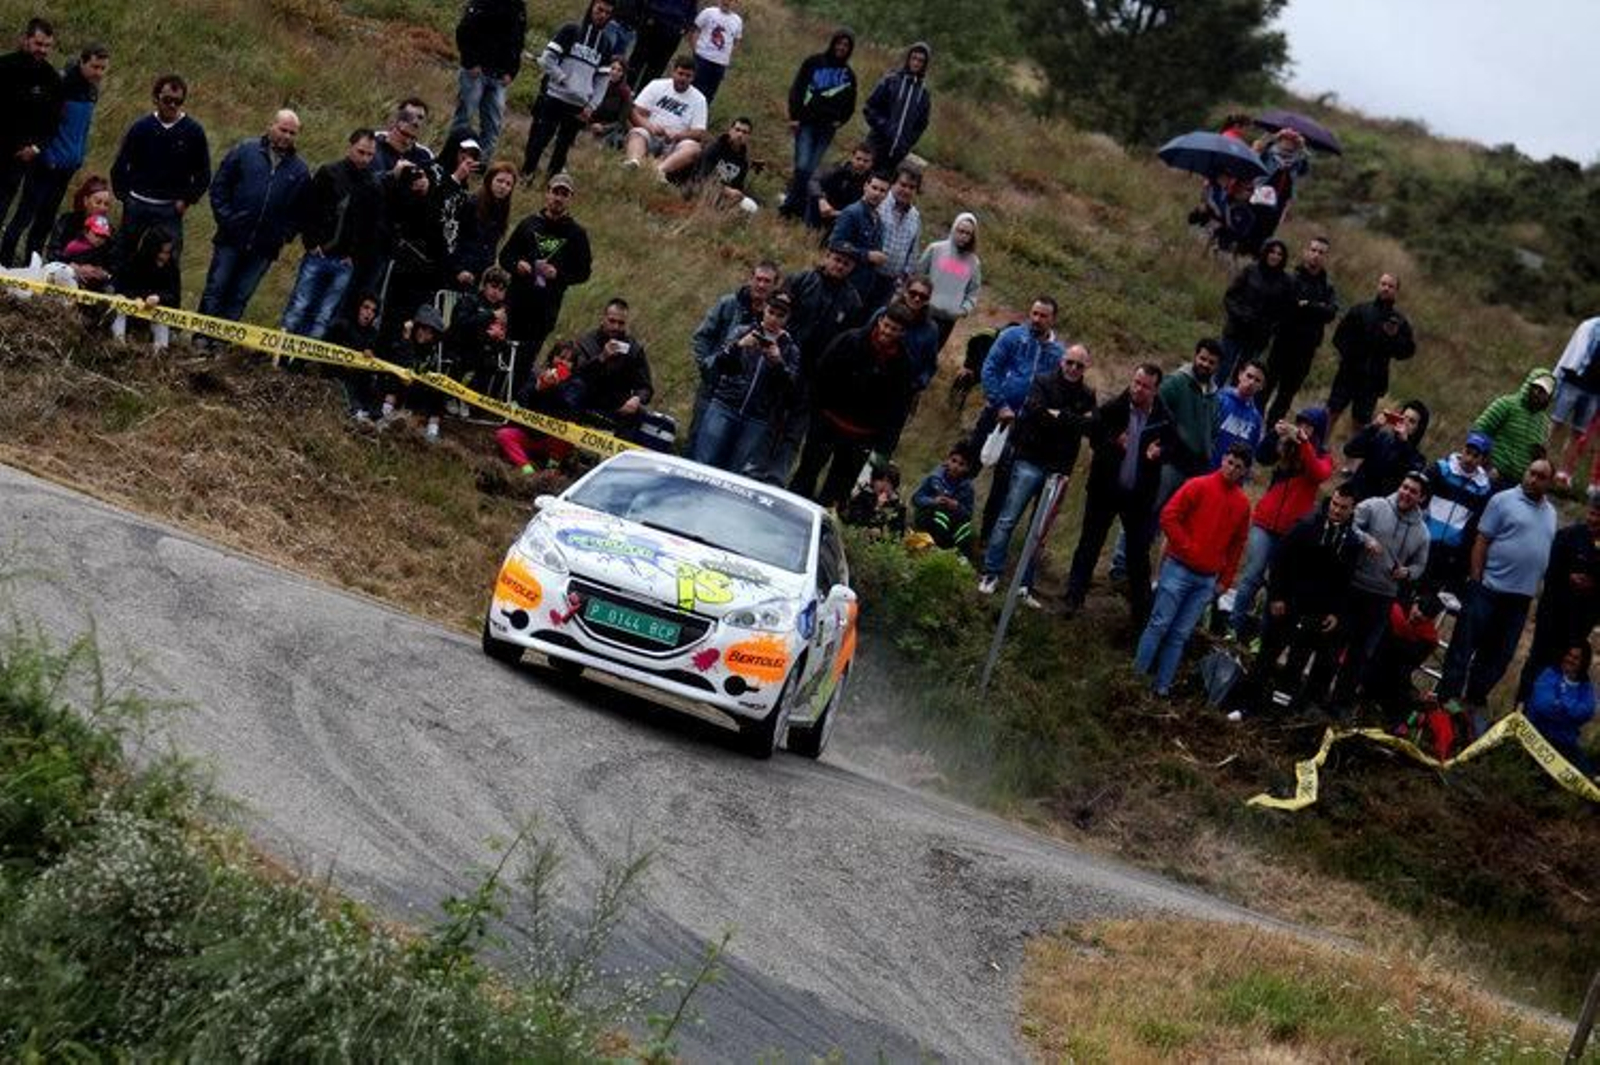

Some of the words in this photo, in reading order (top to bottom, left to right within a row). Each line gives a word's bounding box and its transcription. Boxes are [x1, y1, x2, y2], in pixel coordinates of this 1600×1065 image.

[152, 309, 186, 326] ZONA
[190, 319, 248, 342] PUBLICO
[299, 340, 355, 363] PUBLICO
[579, 430, 616, 452] ZONA
[590, 604, 600, 616] P
[608, 609, 640, 630] 0144
